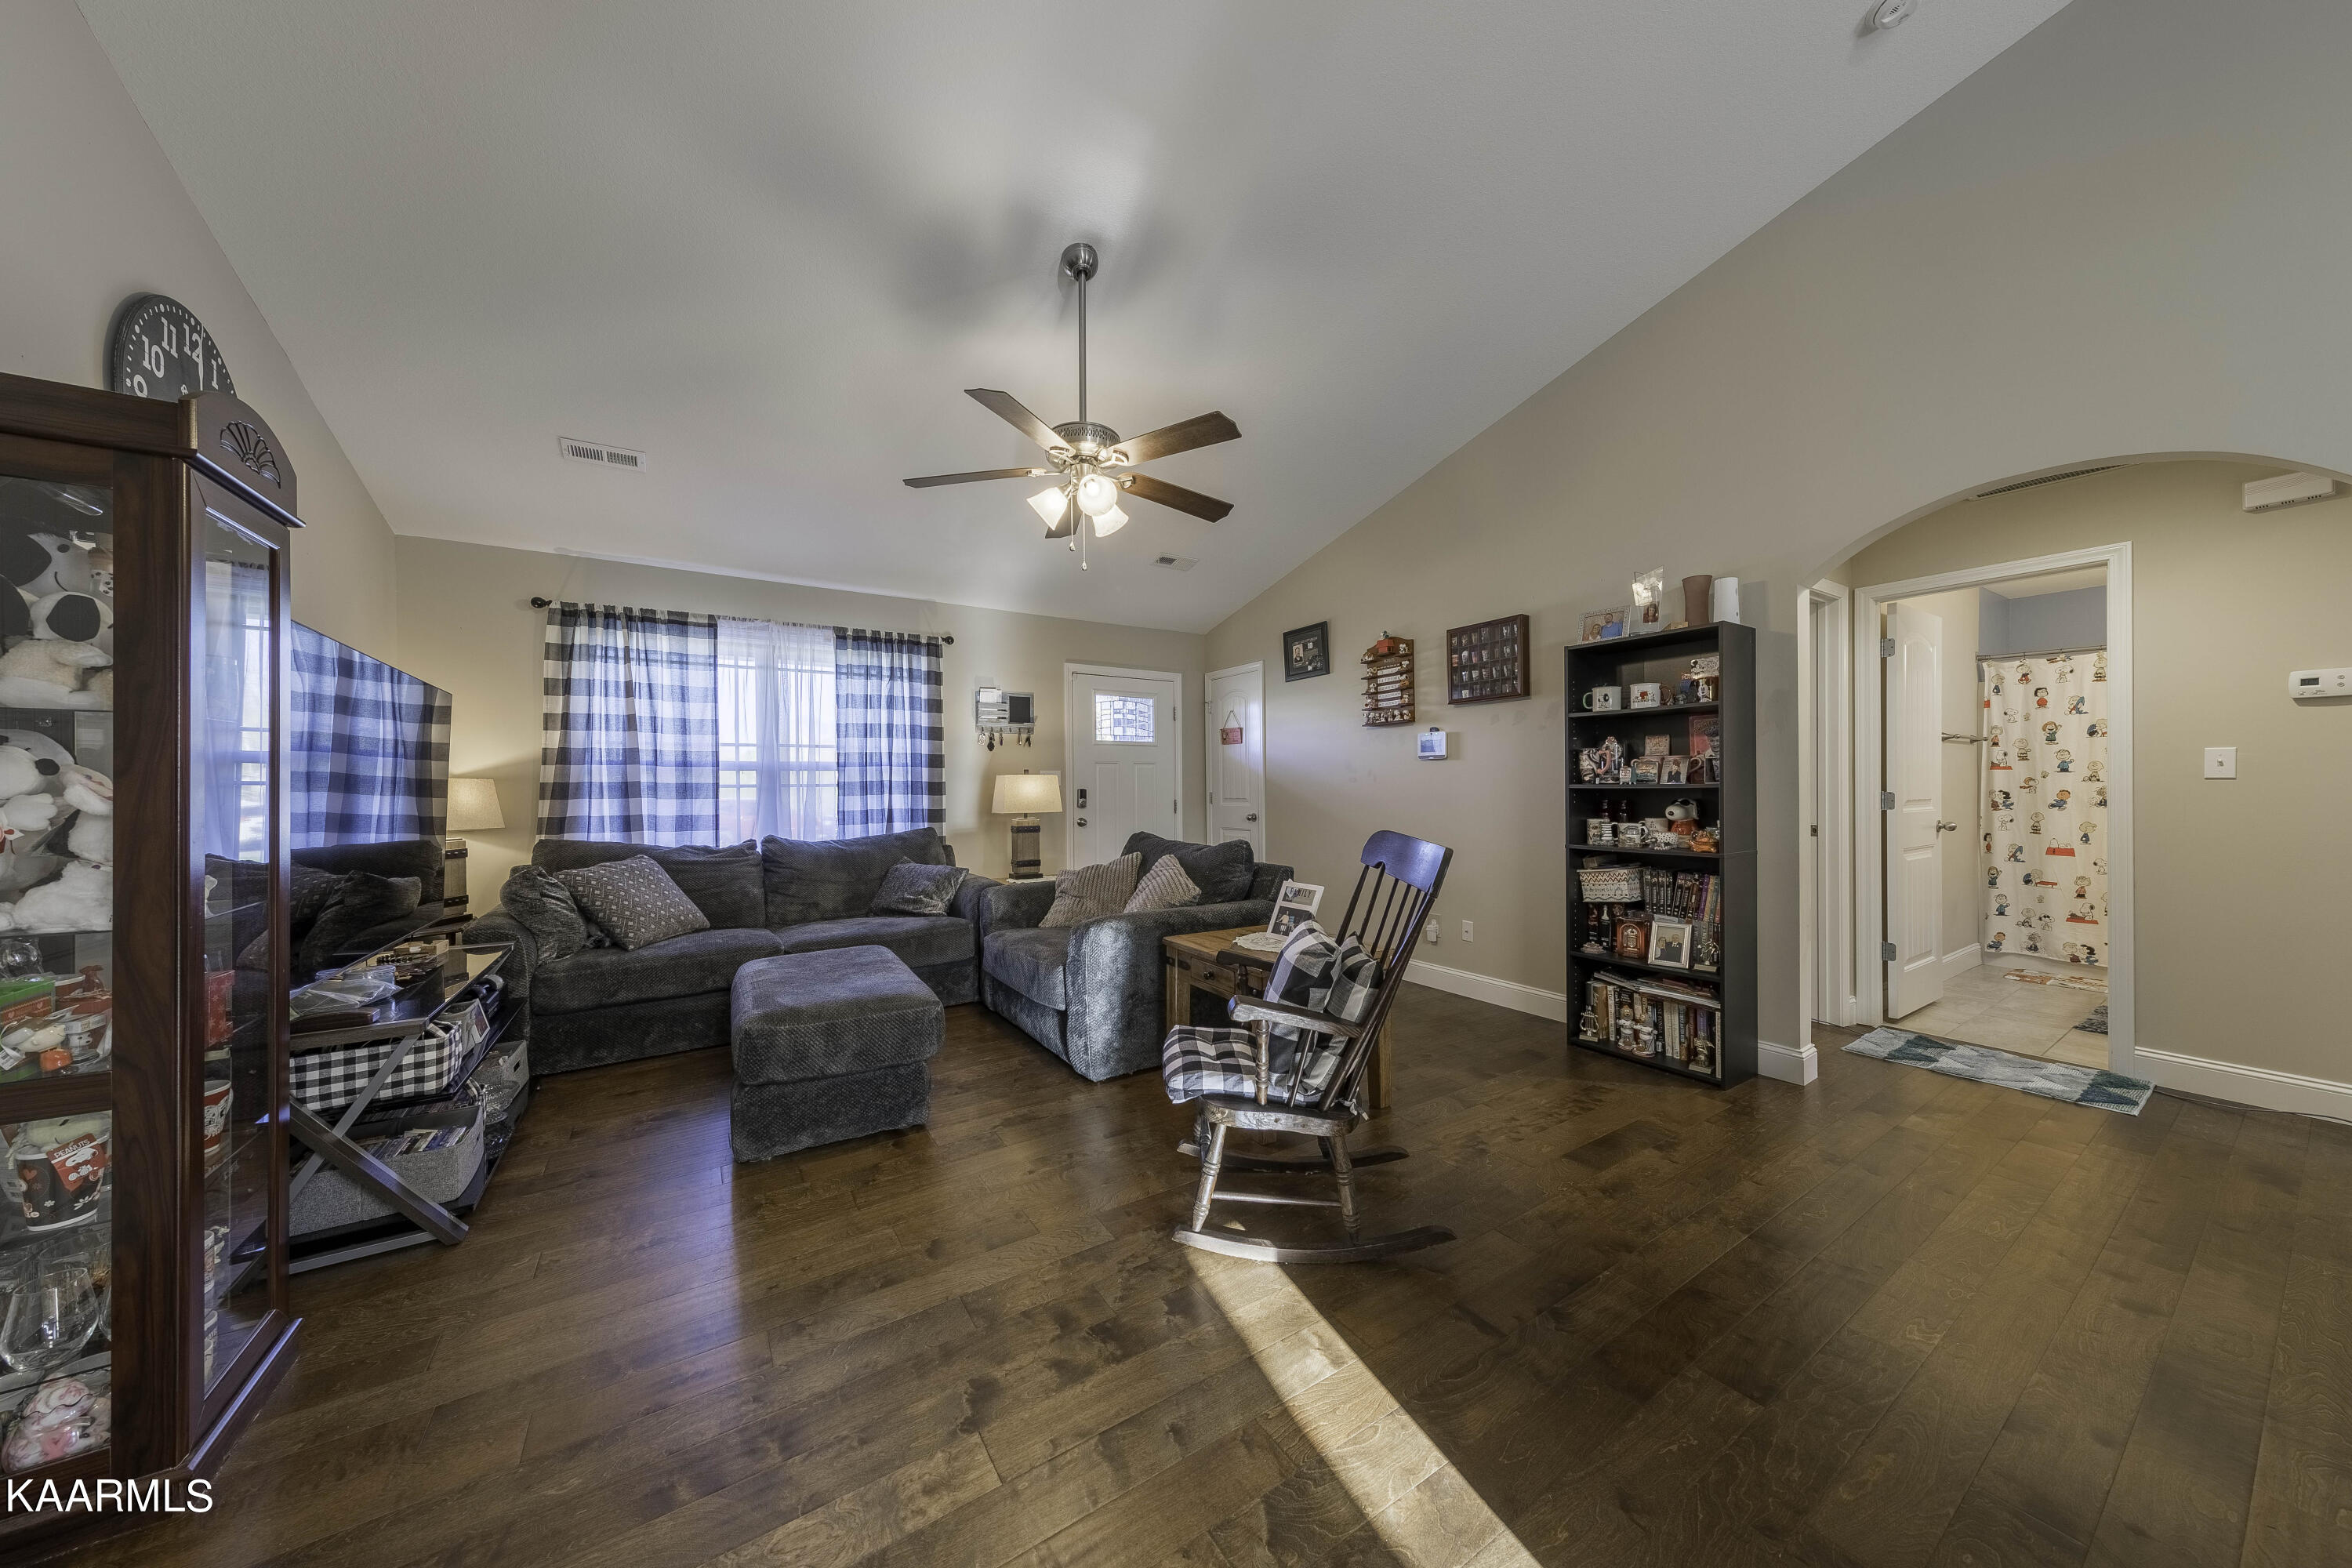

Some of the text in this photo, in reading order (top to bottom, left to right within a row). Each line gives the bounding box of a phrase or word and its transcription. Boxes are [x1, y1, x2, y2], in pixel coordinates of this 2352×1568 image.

[141, 334, 165, 378] 10
[161, 317, 179, 359] 11
[183, 322, 202, 364] 12
[211, 358, 219, 390] 1
[1290, 887, 1312, 898] FAMILY
[53, 1138, 90, 1159] PEANUTS
